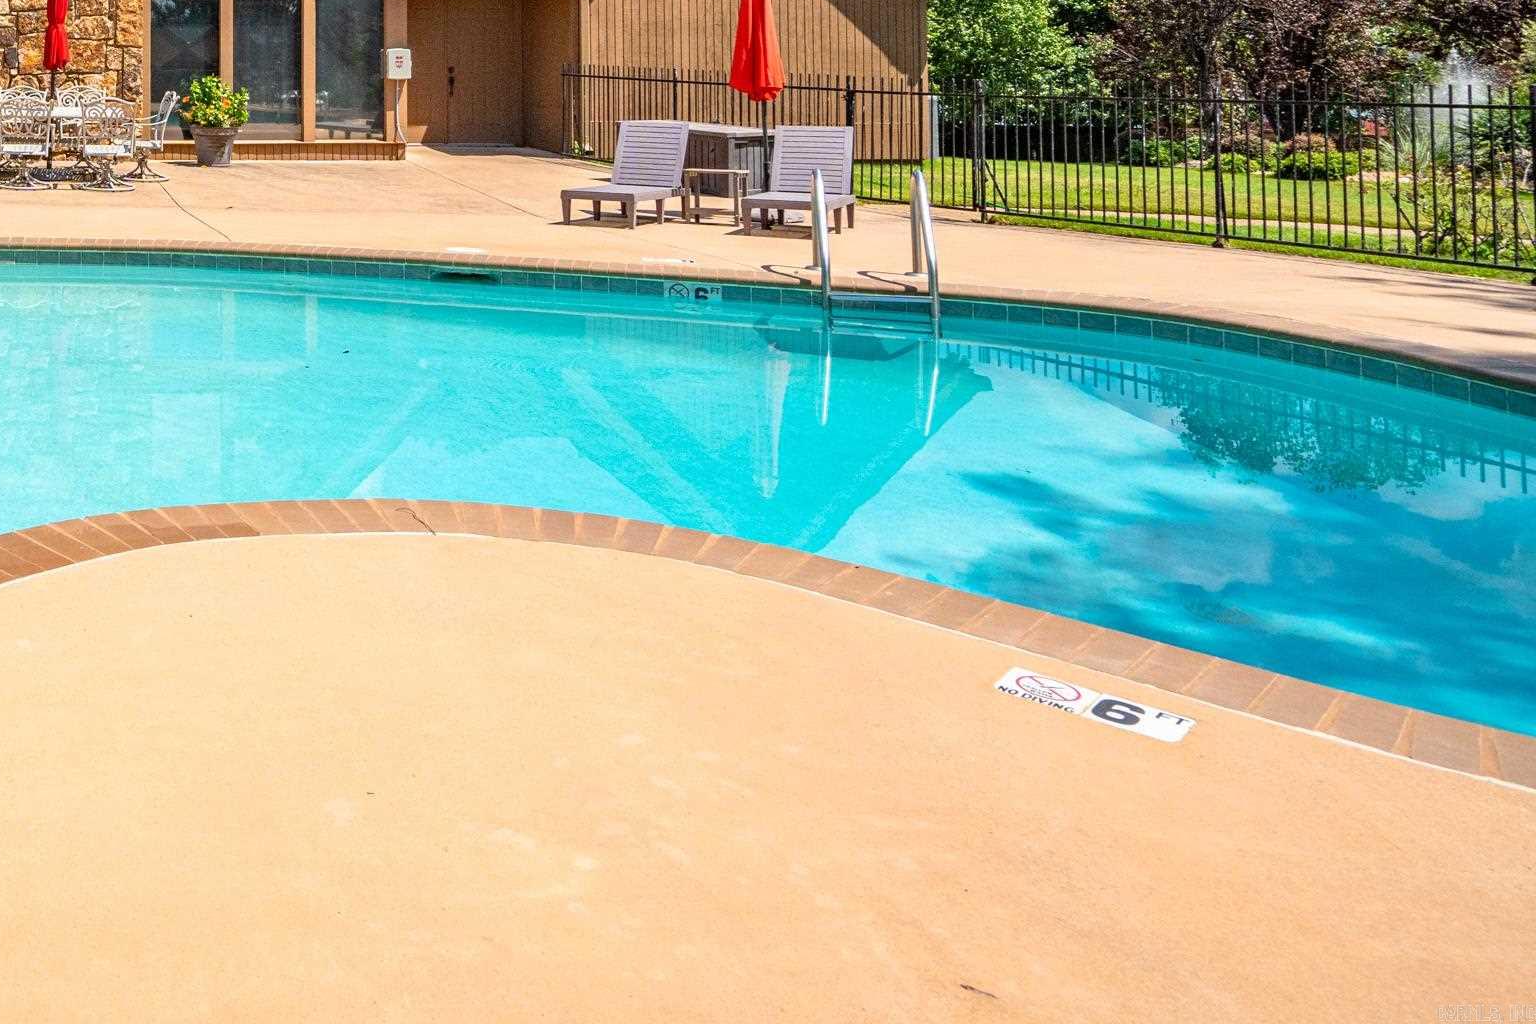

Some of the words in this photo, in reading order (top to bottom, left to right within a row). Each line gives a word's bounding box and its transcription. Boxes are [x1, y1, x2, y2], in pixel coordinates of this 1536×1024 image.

[710, 287, 720, 295] FT
[998, 685, 1019, 695] NO
[1021, 693, 1075, 713] DIVING
[1091, 698, 1146, 726] 6
[1155, 712, 1191, 726] FT
